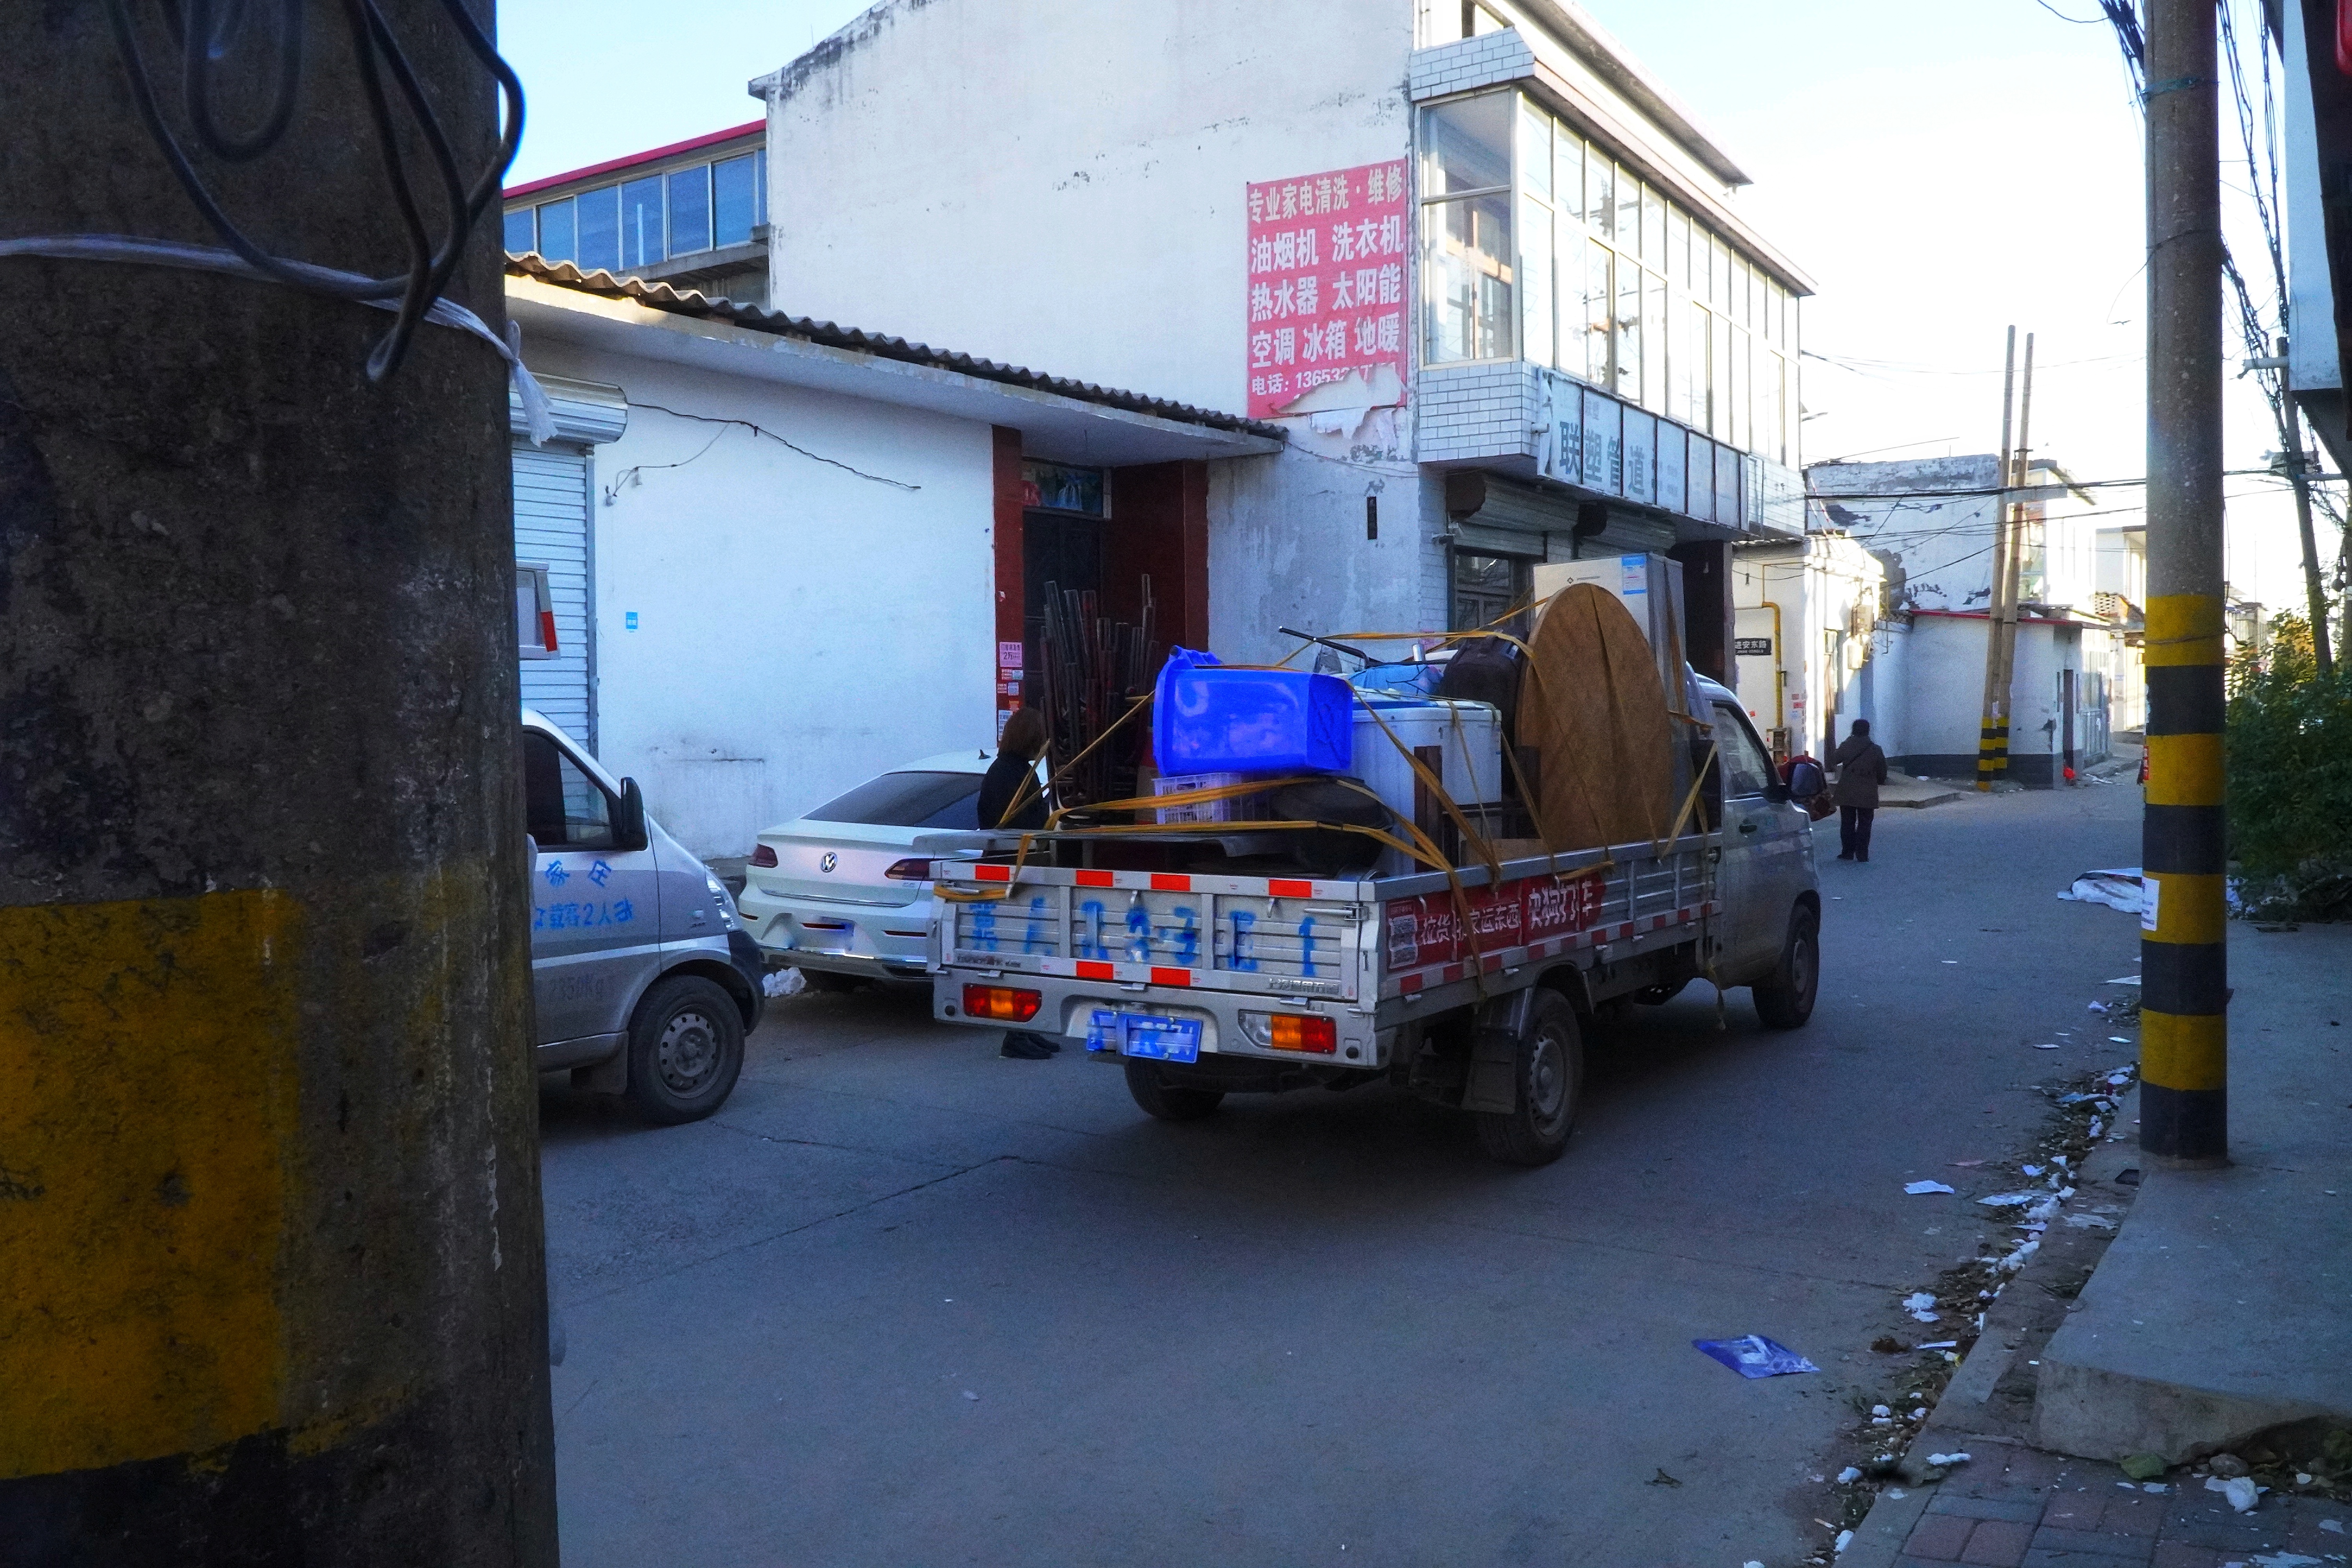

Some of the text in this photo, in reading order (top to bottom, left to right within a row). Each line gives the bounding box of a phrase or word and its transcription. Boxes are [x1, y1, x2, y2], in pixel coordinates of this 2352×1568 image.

[1251, 215, 1403, 274] 油烟机 洗衣机
[1251, 264, 1401, 322] 热水器 太阳能
[1252, 313, 1399, 369] 空调 冰箱 地暖
